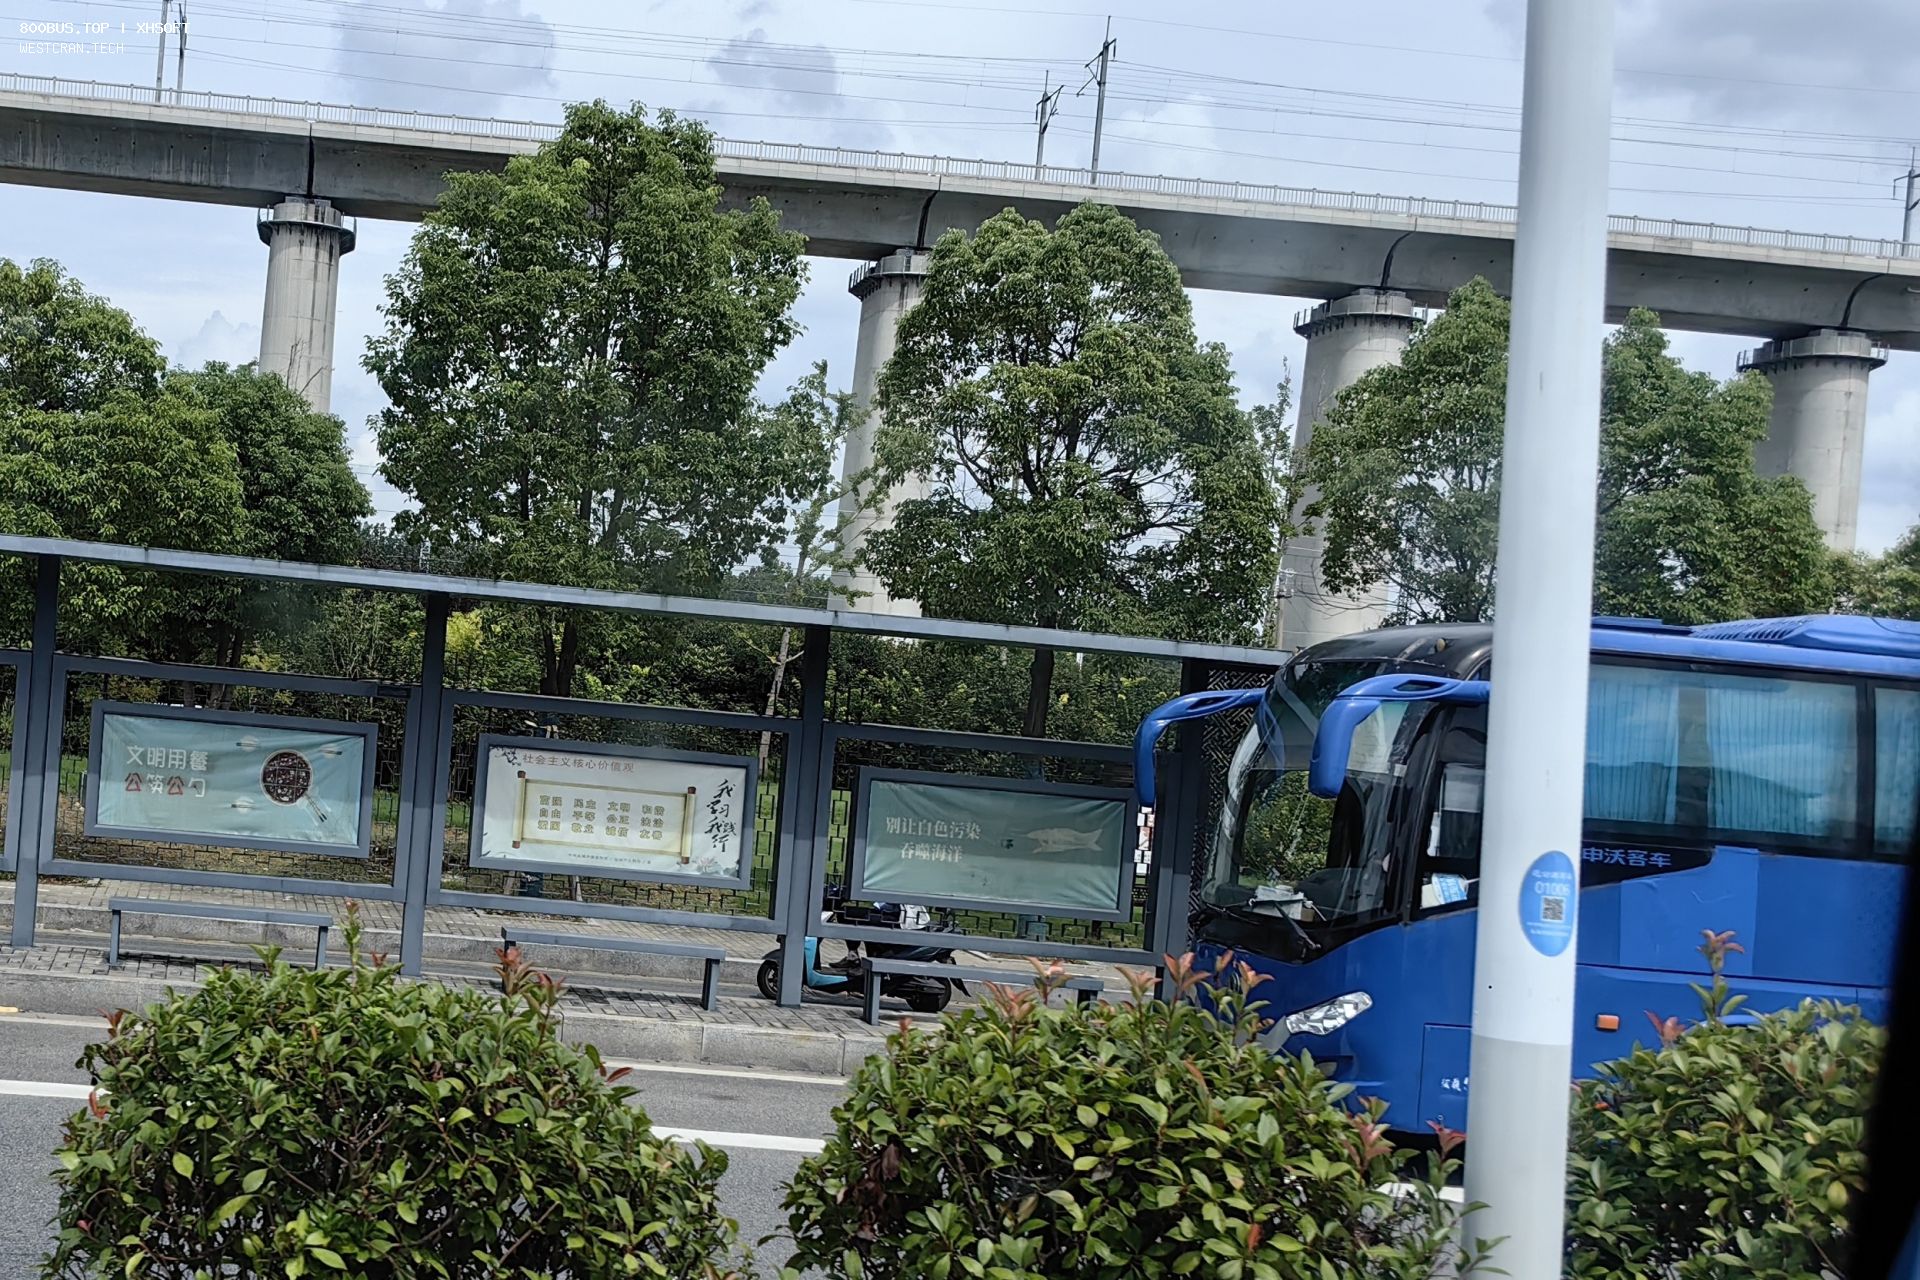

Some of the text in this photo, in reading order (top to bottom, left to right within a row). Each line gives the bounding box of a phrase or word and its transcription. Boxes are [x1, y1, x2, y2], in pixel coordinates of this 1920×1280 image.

[126, 745, 208, 771] 文明用餐
[522, 753, 635, 774] 社会主义核心价值观
[125, 772, 206, 798] 公筷公勺
[539, 807, 561, 819] 自由
[572, 810, 595, 822] 平等
[606, 814, 629, 825] 公正
[574, 798, 597, 810] 民主
[608, 801, 631, 813] 文明
[886, 816, 982, 840] 别让白色污染
[901, 841, 963, 862] 吞噬海洋
[1582, 847, 1672, 868] 申沃客车
